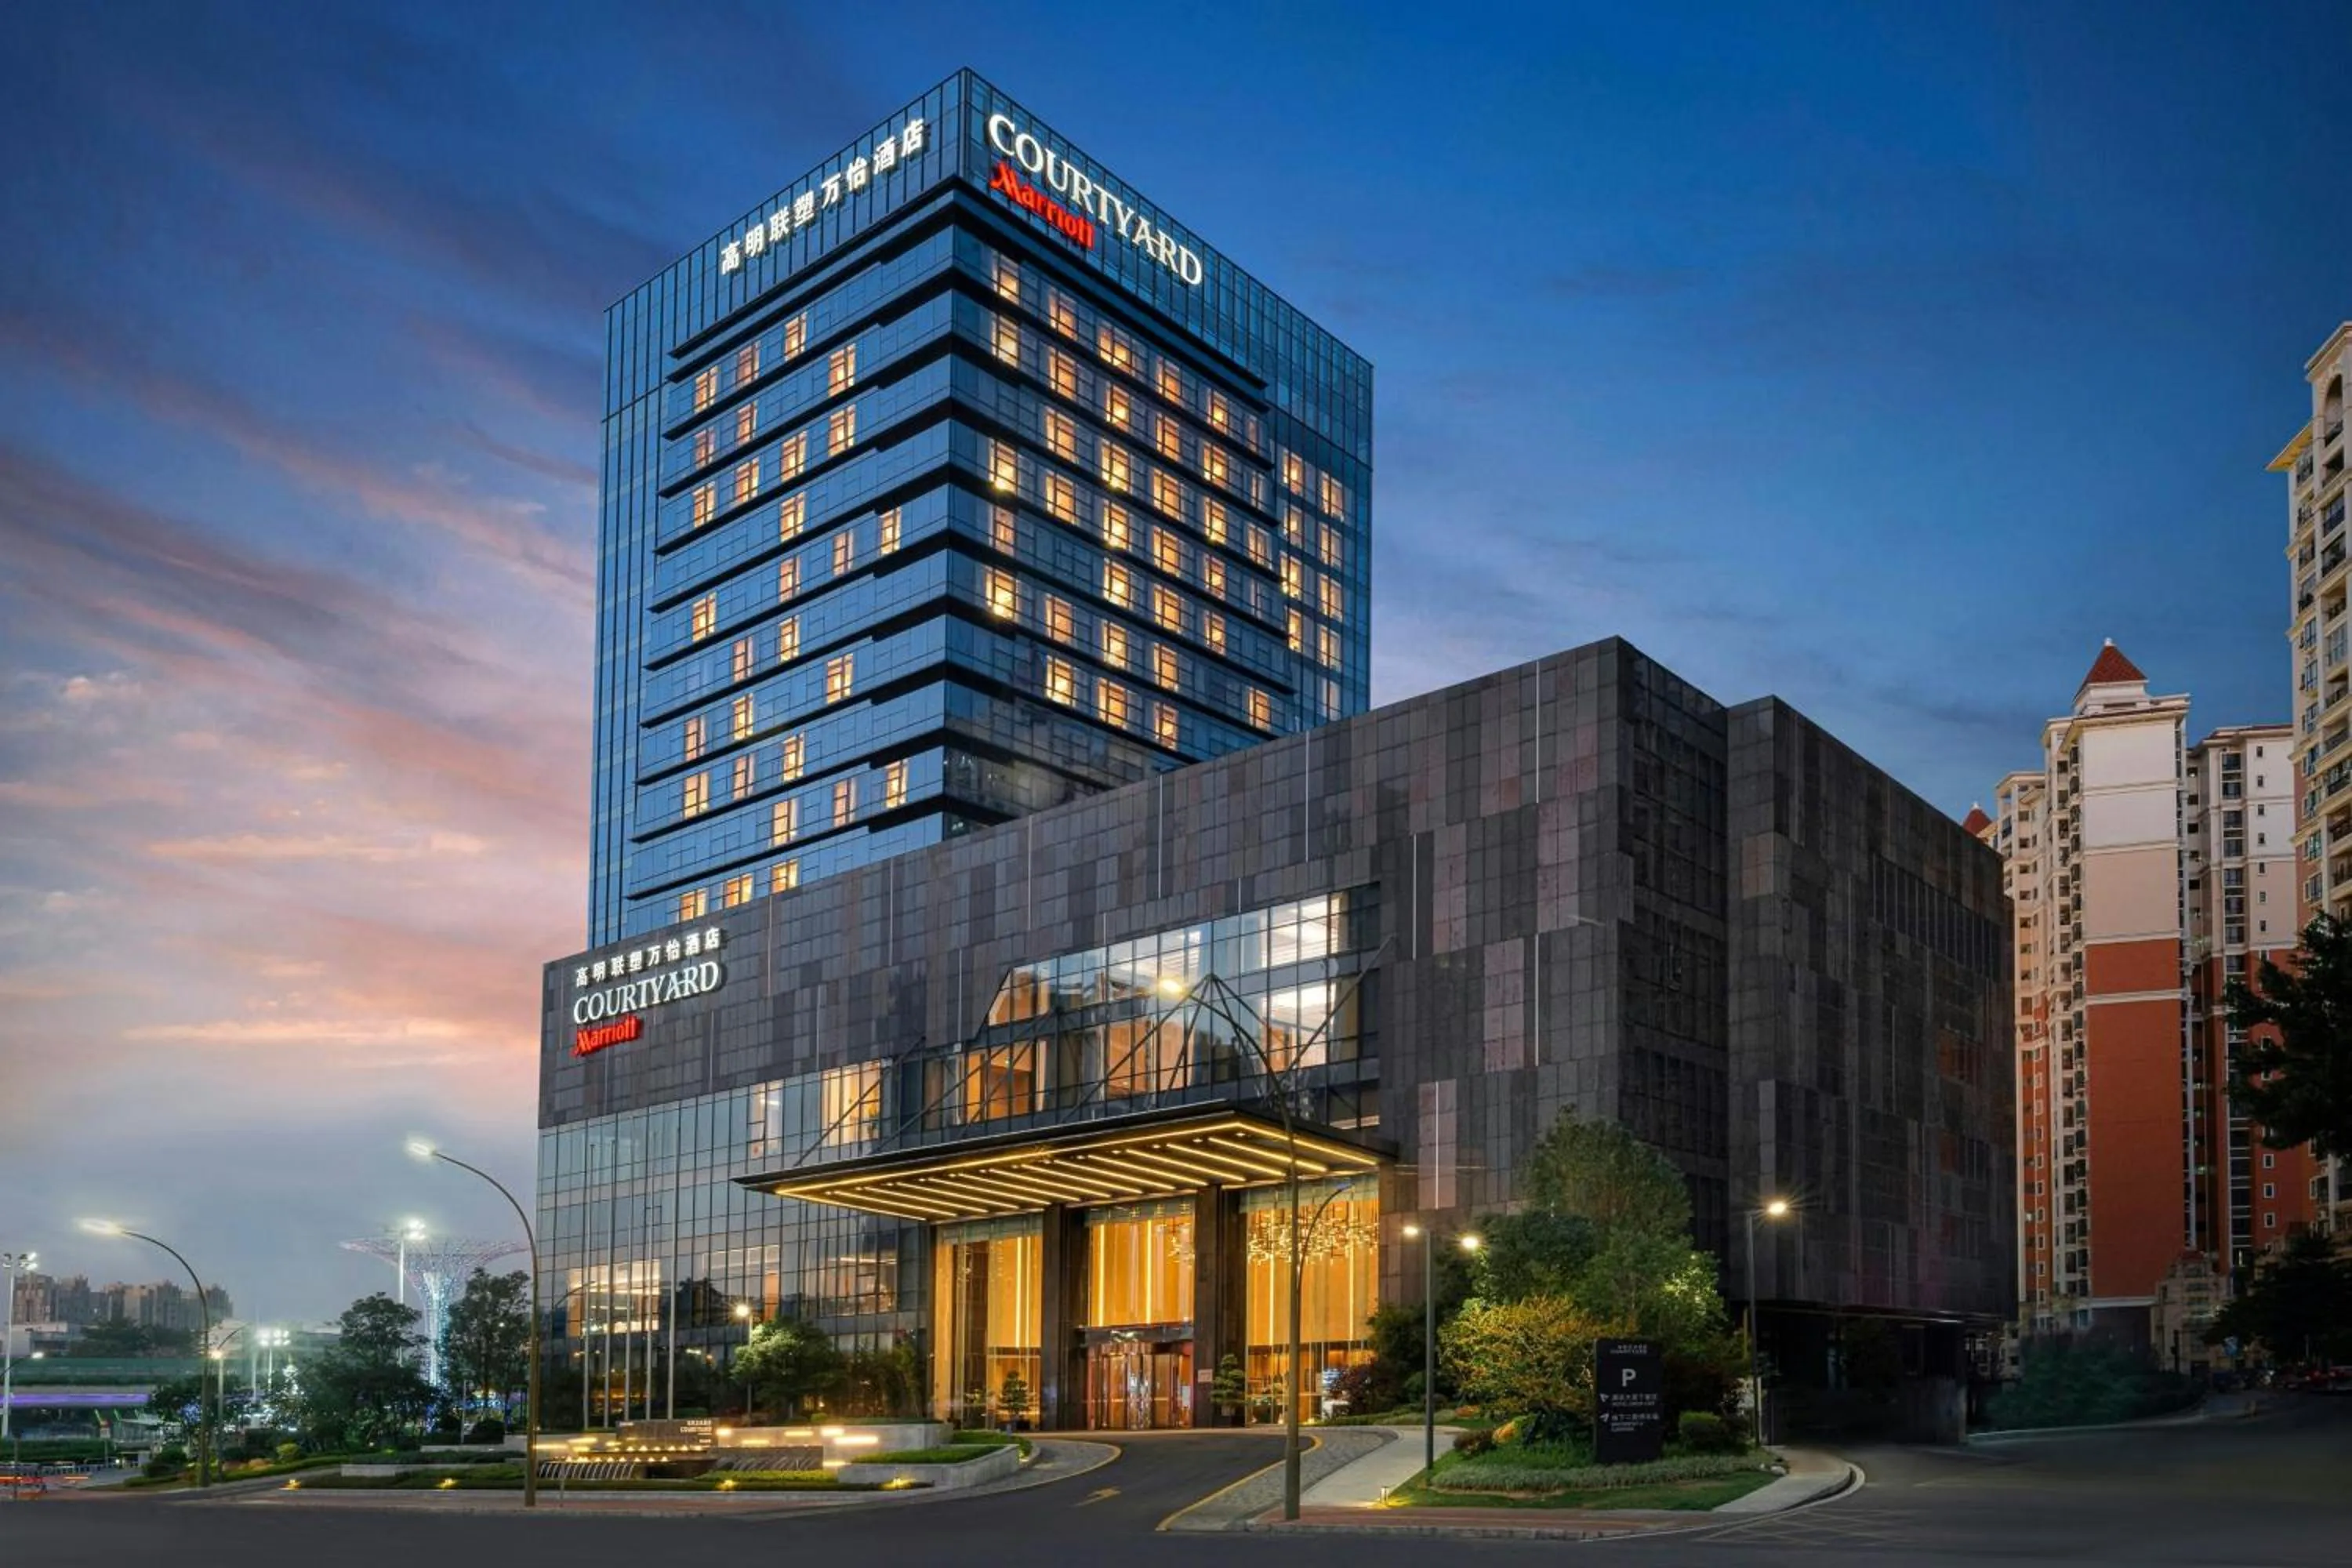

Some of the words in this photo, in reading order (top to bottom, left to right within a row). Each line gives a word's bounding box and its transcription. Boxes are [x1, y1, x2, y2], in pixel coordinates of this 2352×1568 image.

[720, 118, 924, 275] 高明联塑万怡酒店
[989, 114, 1202, 285] COURTYARD
[990, 162, 1095, 249] Marriott
[575, 927, 720, 988] 高明联塑万怡酒店
[573, 960, 720, 1025] COURTYARD
[573, 1016, 638, 1056] Marriott
[1622, 1368, 1637, 1387] P
